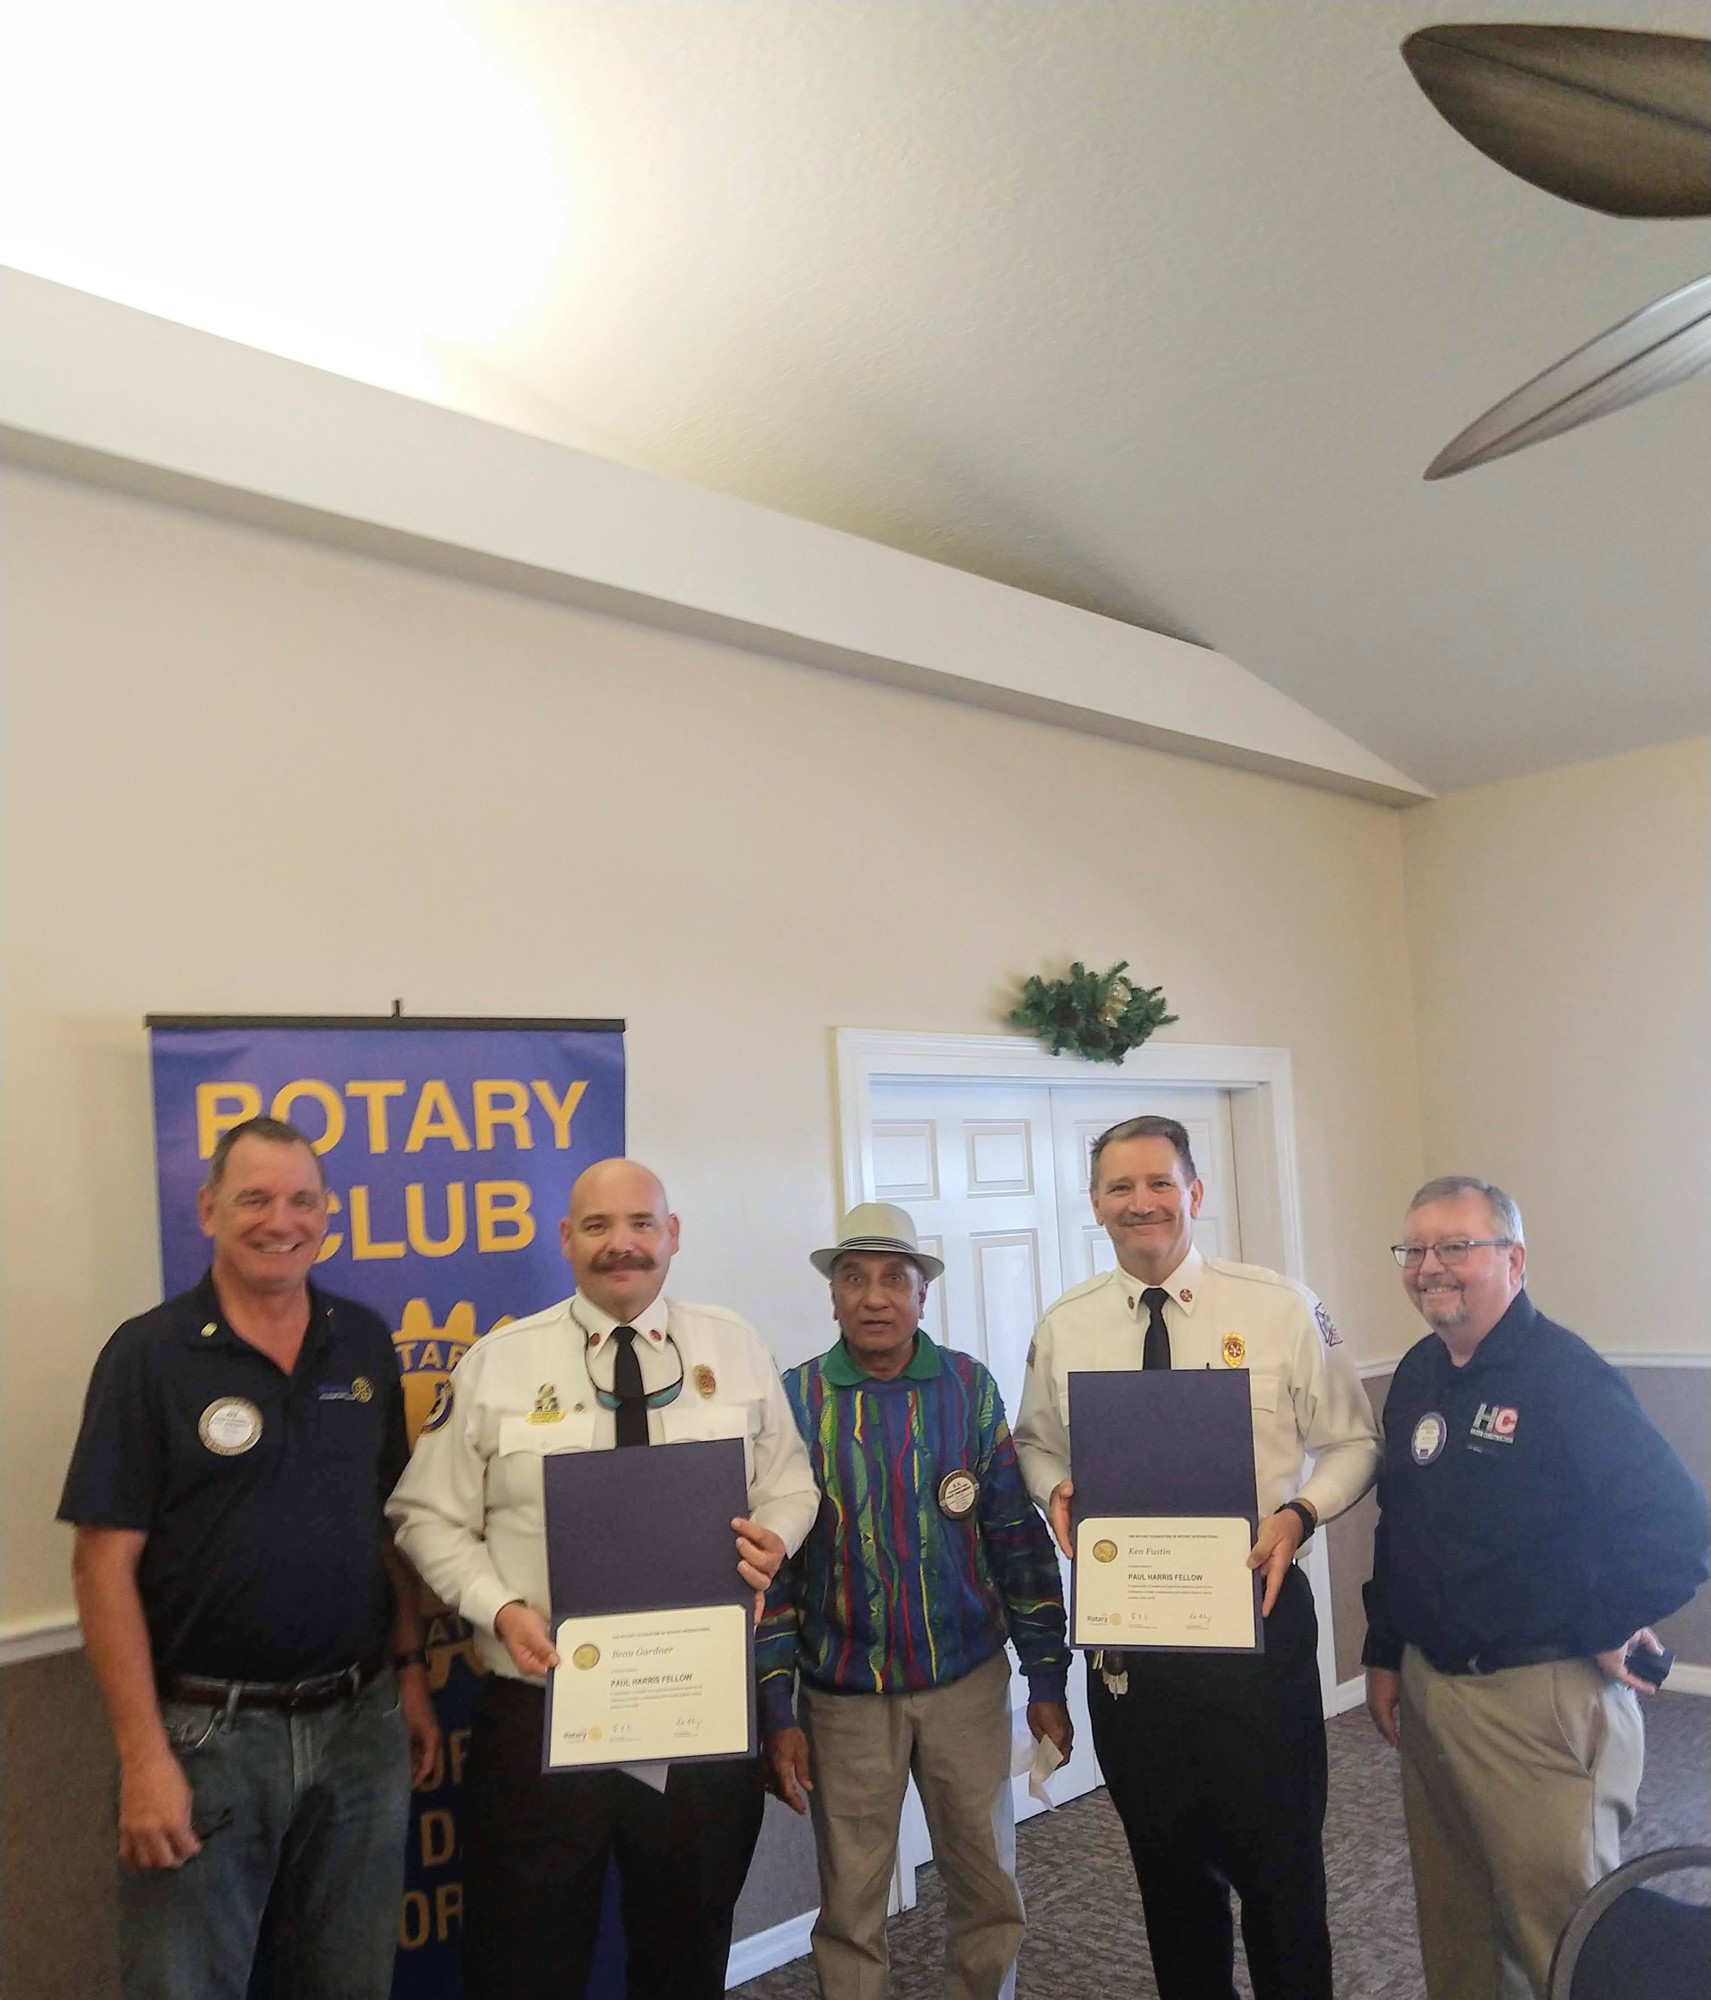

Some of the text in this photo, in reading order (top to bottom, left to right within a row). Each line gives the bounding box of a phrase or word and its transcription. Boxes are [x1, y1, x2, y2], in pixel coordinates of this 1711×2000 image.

[195, 1078, 590, 1160] ROTARY
[1472, 1403, 1518, 1434] HC
[1128, 1547, 1144, 1555] Ken
[1087, 1615, 1108, 1624] Rotary
[635, 1645, 674, 1657] Gardner
[610, 1673, 693, 1688] PAUL HARRIS FELLOW
